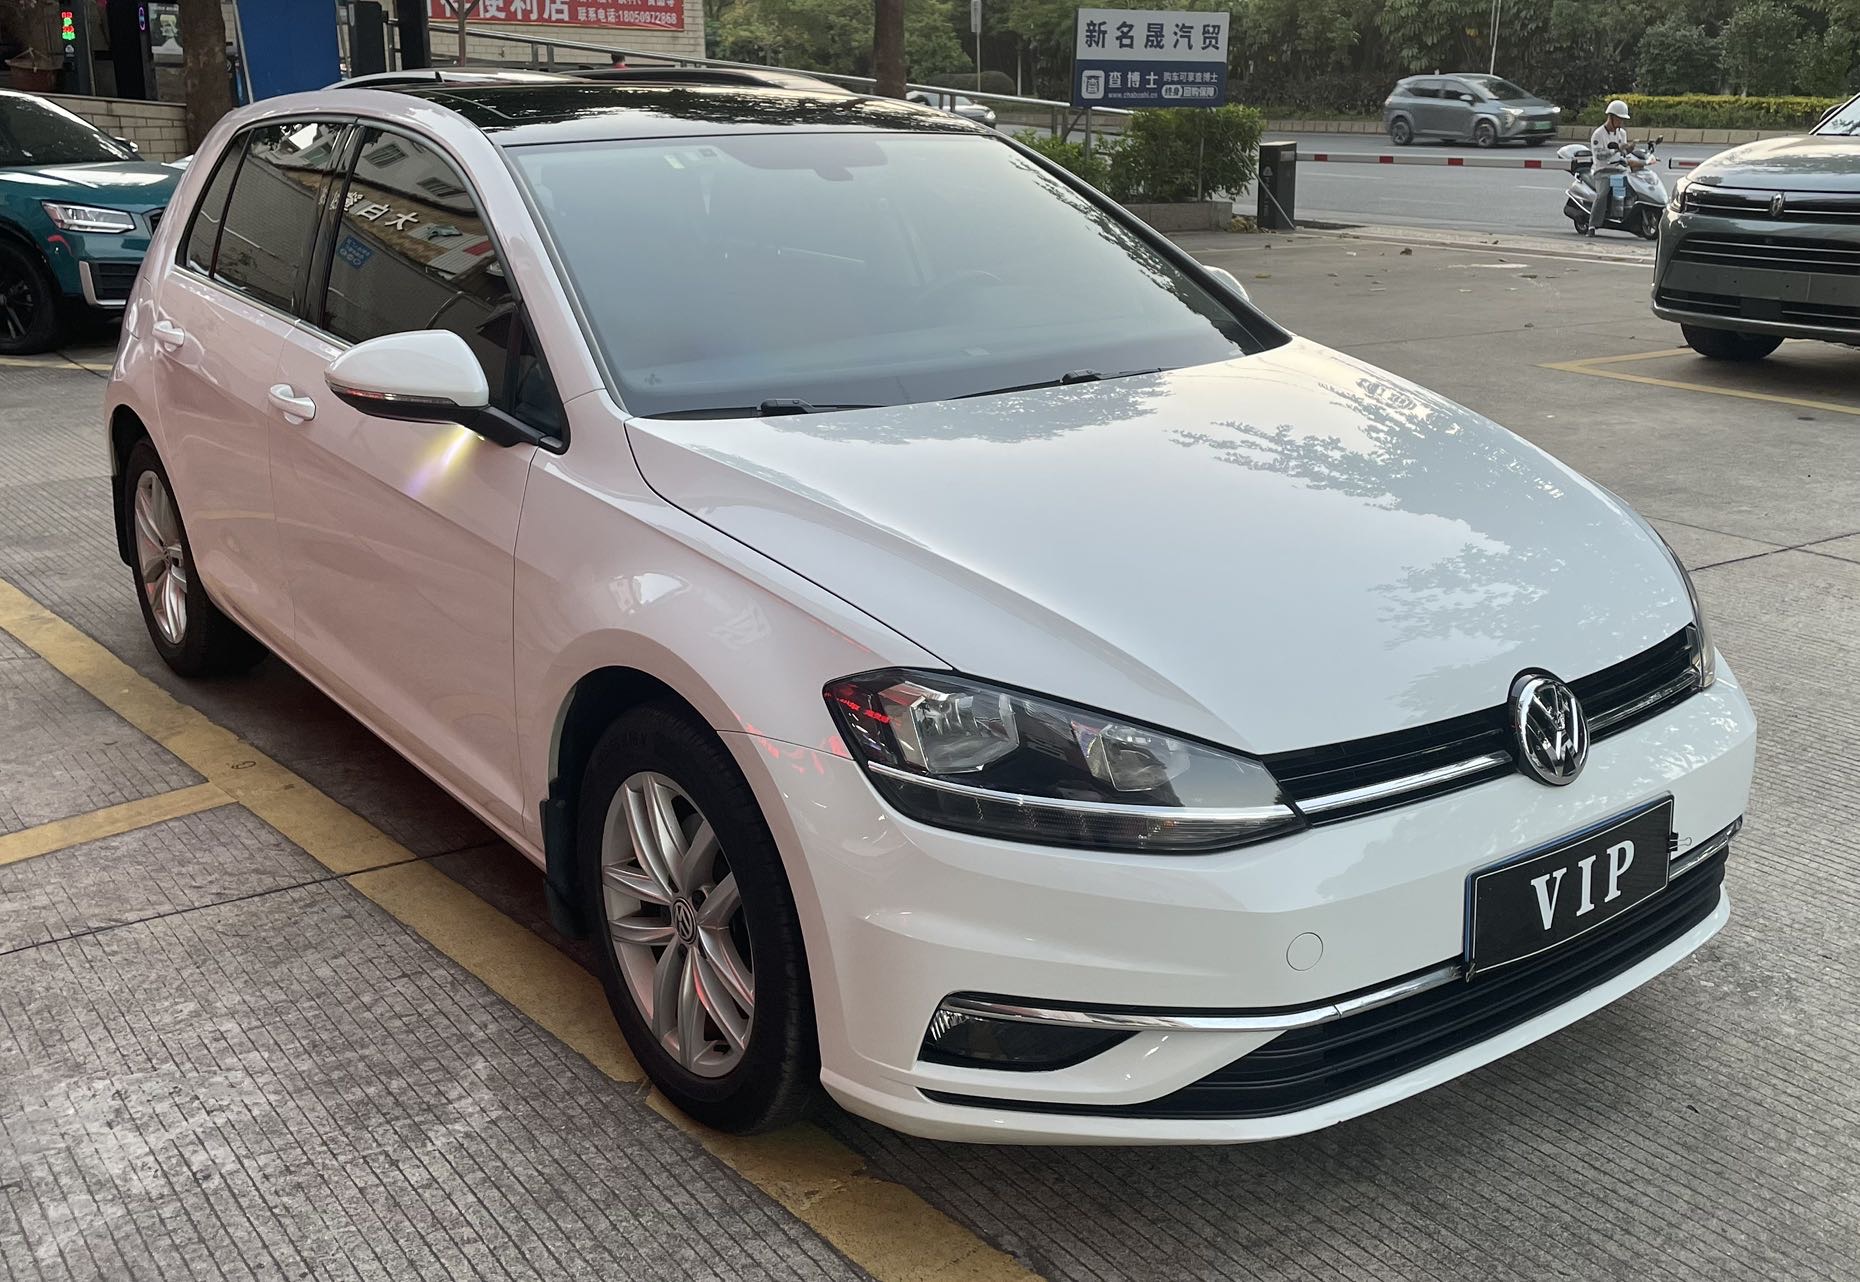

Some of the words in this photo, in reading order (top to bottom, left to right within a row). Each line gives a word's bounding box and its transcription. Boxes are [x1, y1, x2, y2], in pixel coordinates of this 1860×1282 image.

[1085, 20, 1221, 50] 新名晟汽贸
[1108, 72, 1158, 88] 查博士
[1530, 840, 1635, 931] VIP
